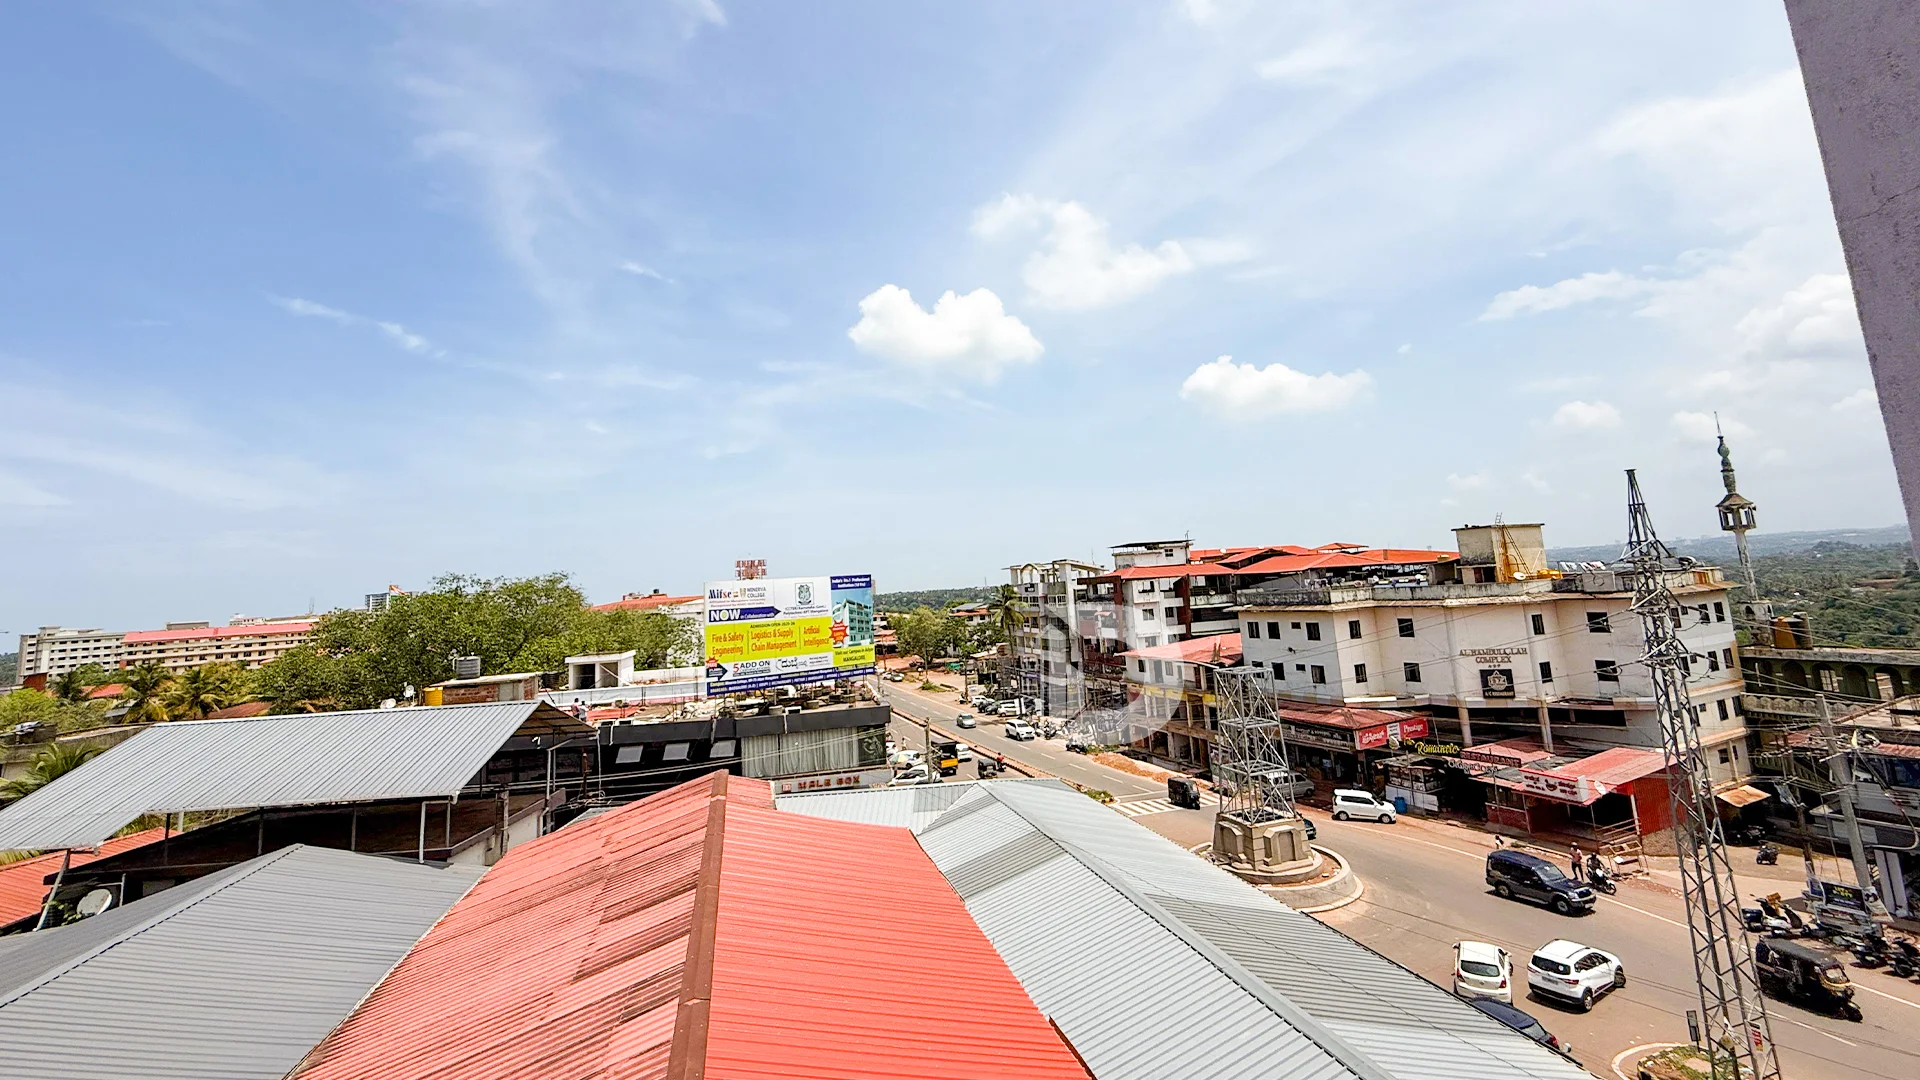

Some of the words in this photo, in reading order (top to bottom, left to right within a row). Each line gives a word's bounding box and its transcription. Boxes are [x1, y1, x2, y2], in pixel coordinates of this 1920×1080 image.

[710, 609, 741, 622] NOW
[751, 630, 772, 641] Logistics
[777, 628, 793, 639] Supply
[803, 625, 820, 635] Artificial
[712, 633, 722, 643] Fire
[728, 632, 744, 642] Safety
[804, 637, 830, 648] Intelligence
[712, 645, 744, 657] Engineering
[752, 642, 766, 652] Chain
[766, 640, 797, 651] Management
[1475, 656, 1512, 664] COMPLEX
[733, 663, 740, 673] 5
[1461, 751, 1520, 767] RESTAURANT
